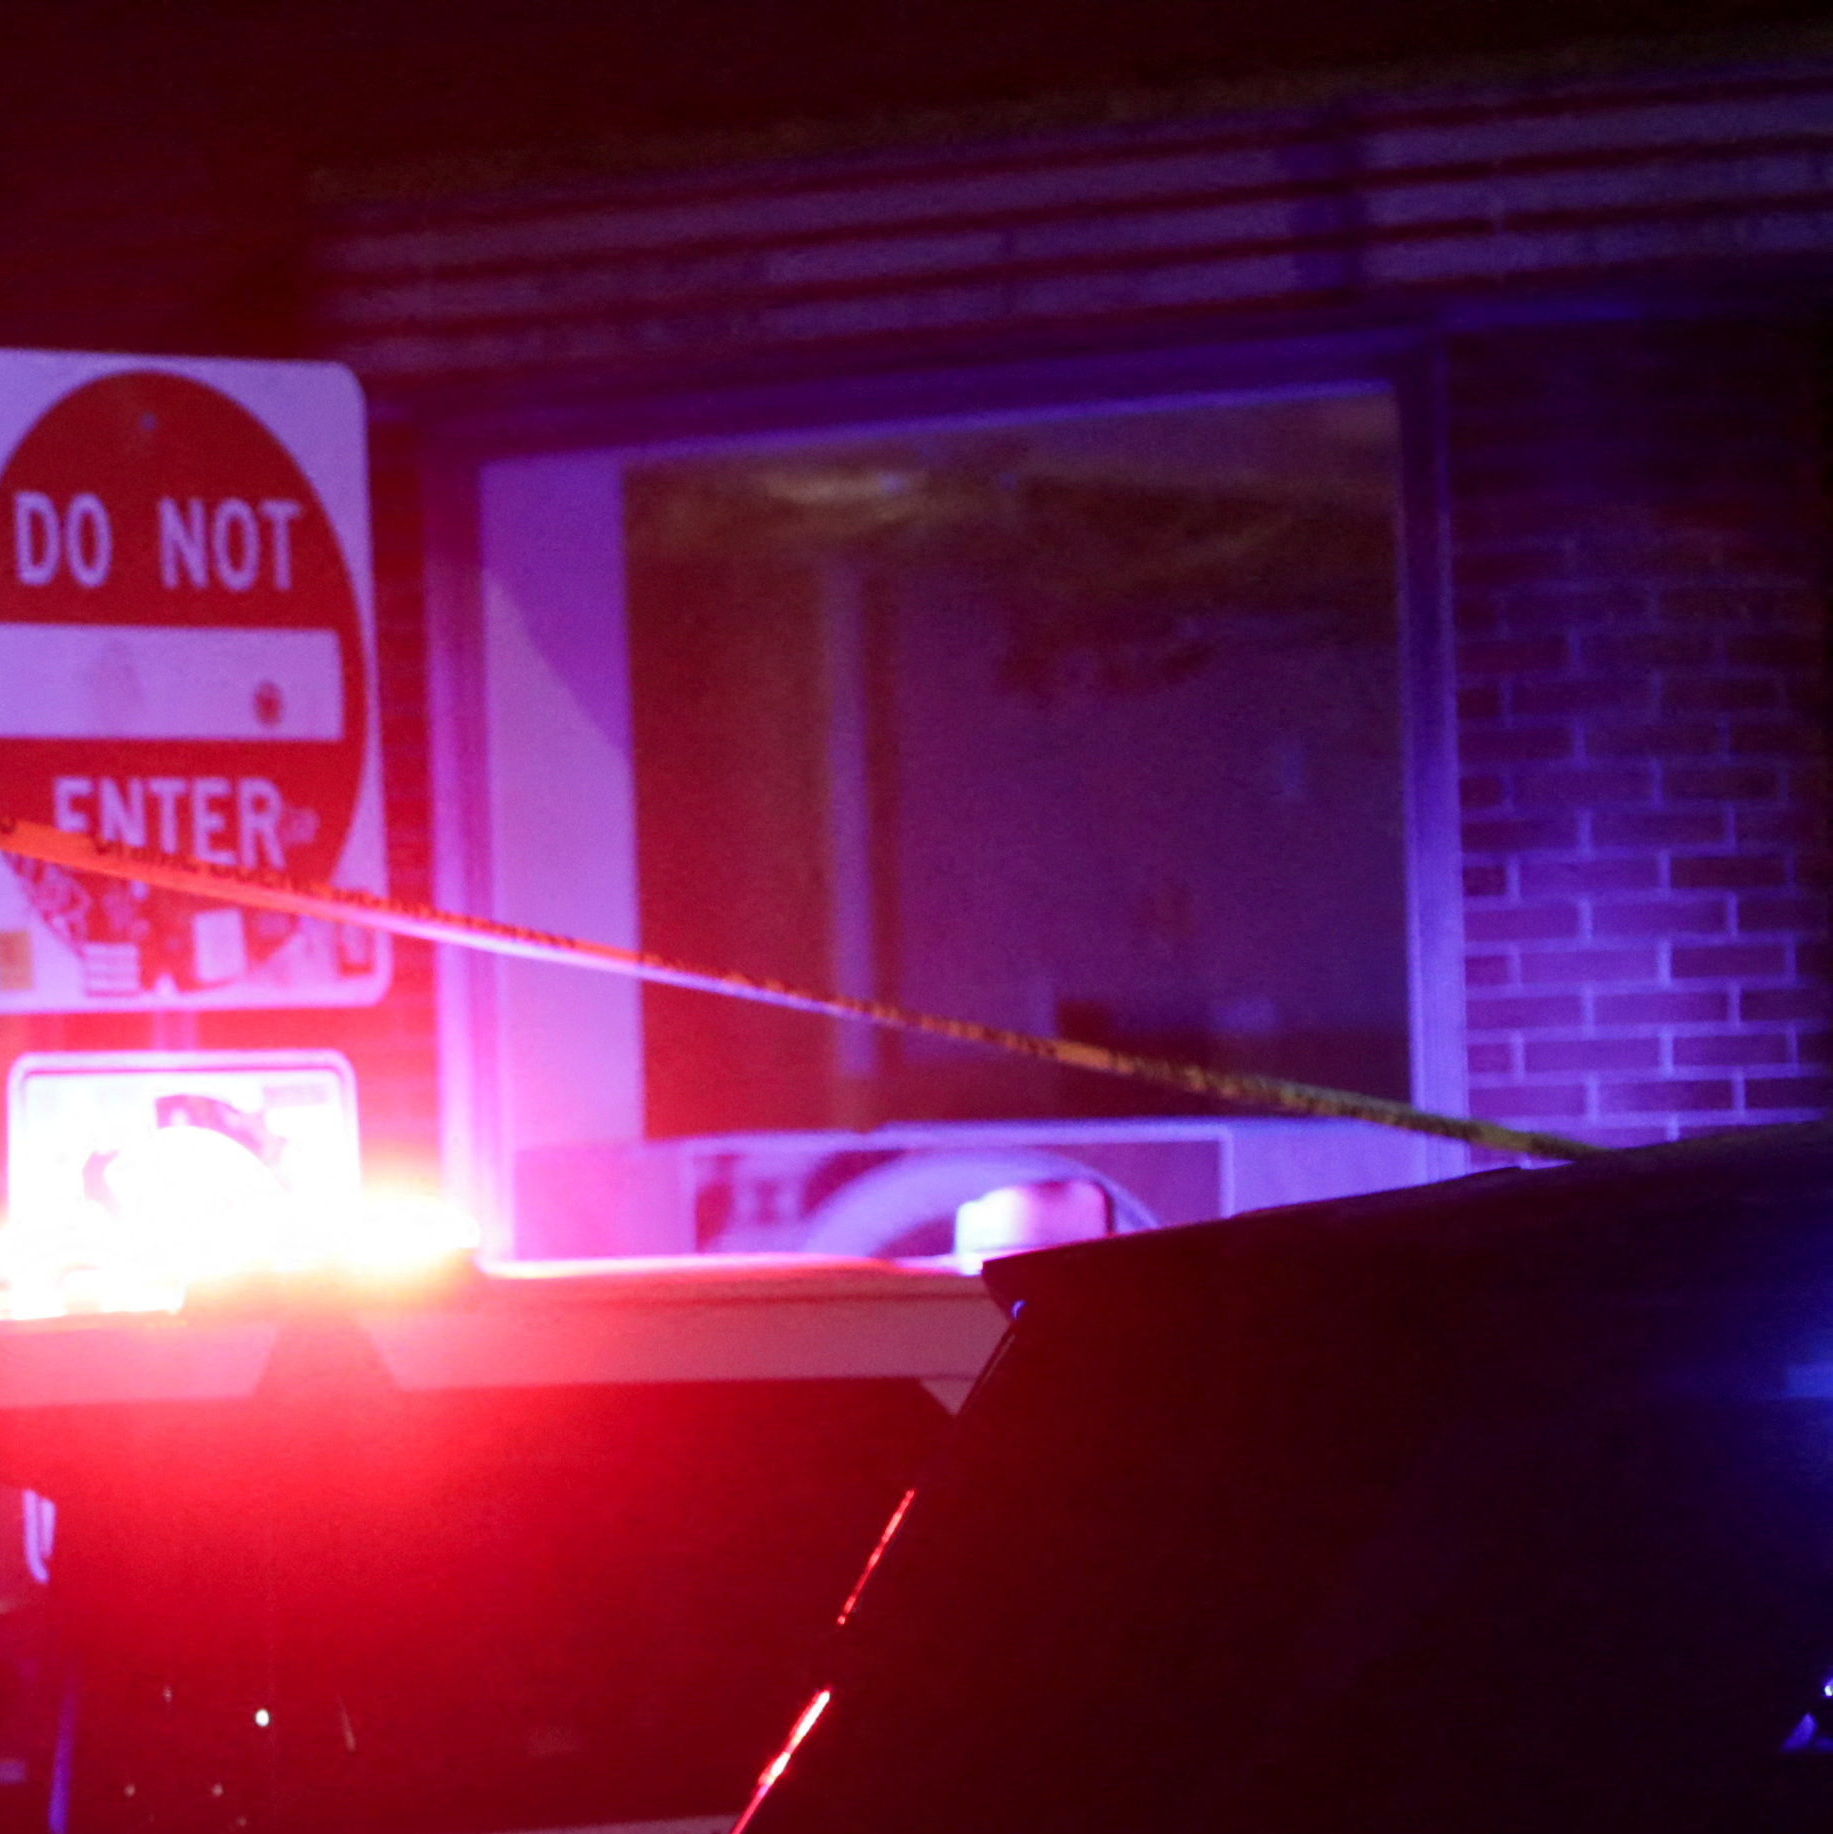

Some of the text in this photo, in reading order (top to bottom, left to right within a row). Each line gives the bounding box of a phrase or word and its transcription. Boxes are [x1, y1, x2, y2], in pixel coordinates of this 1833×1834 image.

[13, 490, 303, 590] DO NOT
[52, 775, 287, 871] ENTER
